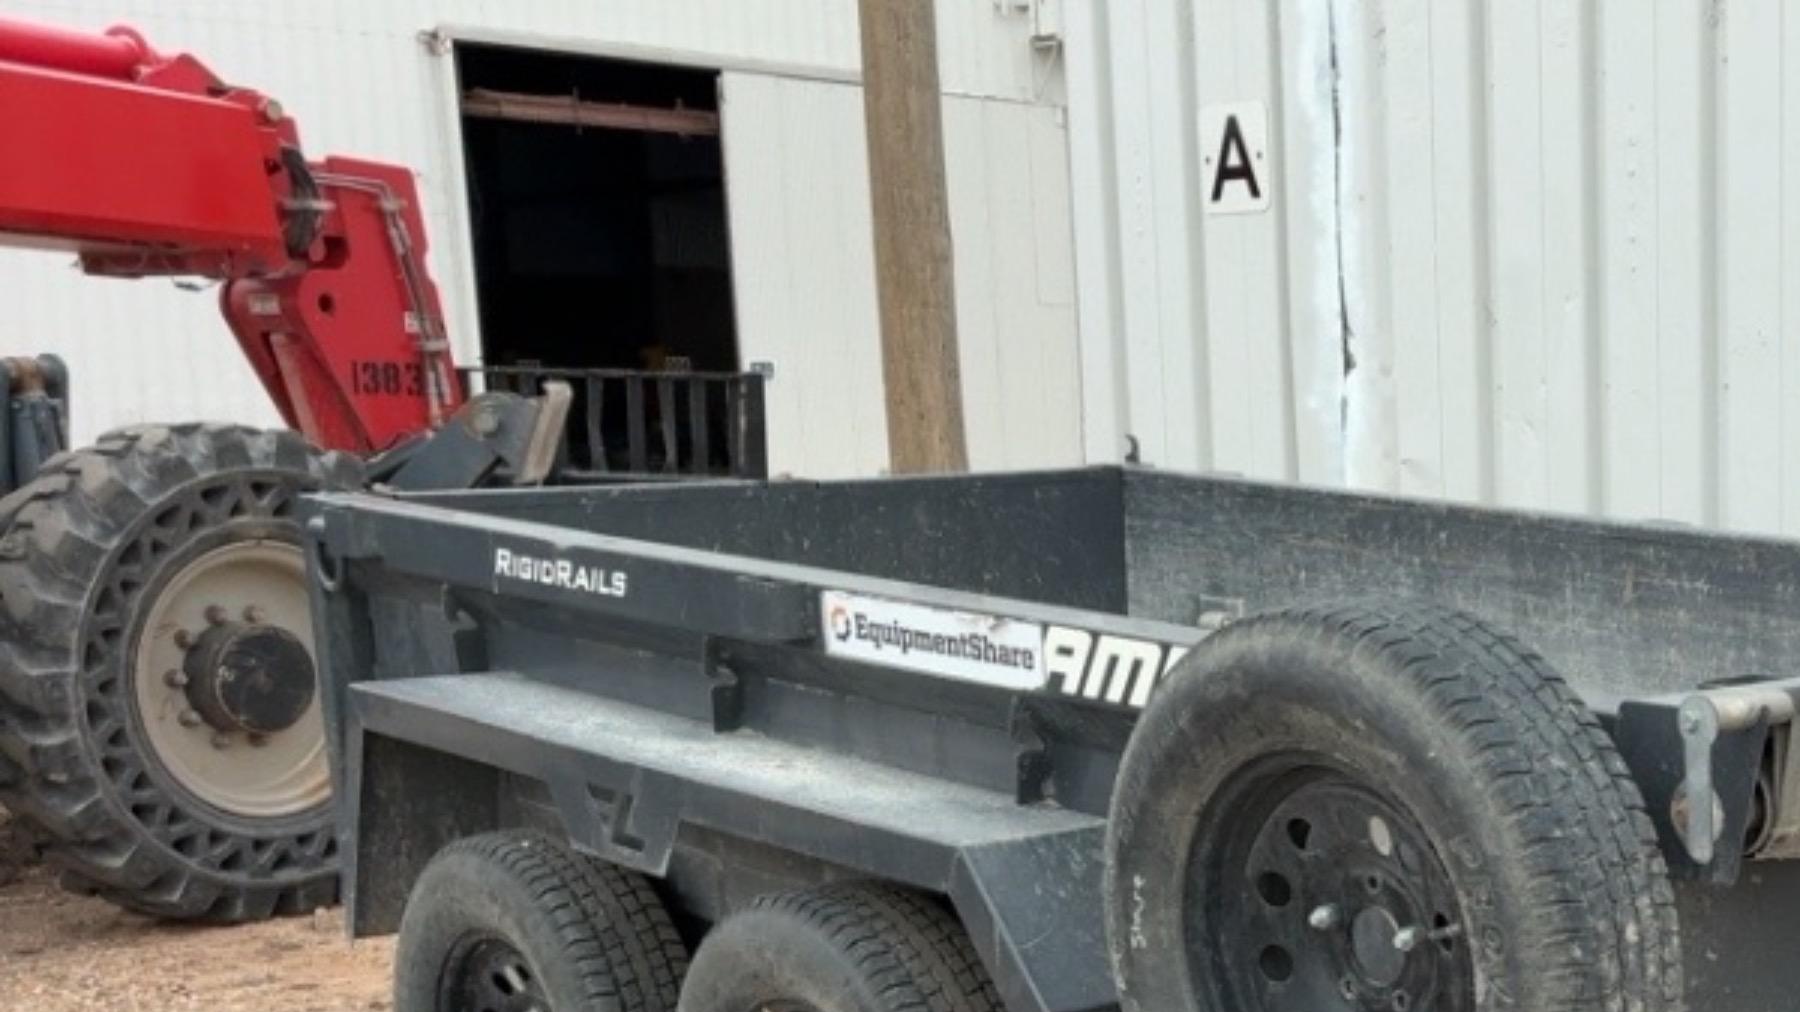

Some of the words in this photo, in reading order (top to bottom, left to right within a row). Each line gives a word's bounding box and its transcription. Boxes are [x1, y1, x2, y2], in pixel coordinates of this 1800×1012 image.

[1211, 114, 1260, 203] A
[854, 612, 1035, 671] EquipmentShare
[1046, 625, 1192, 709] AM
